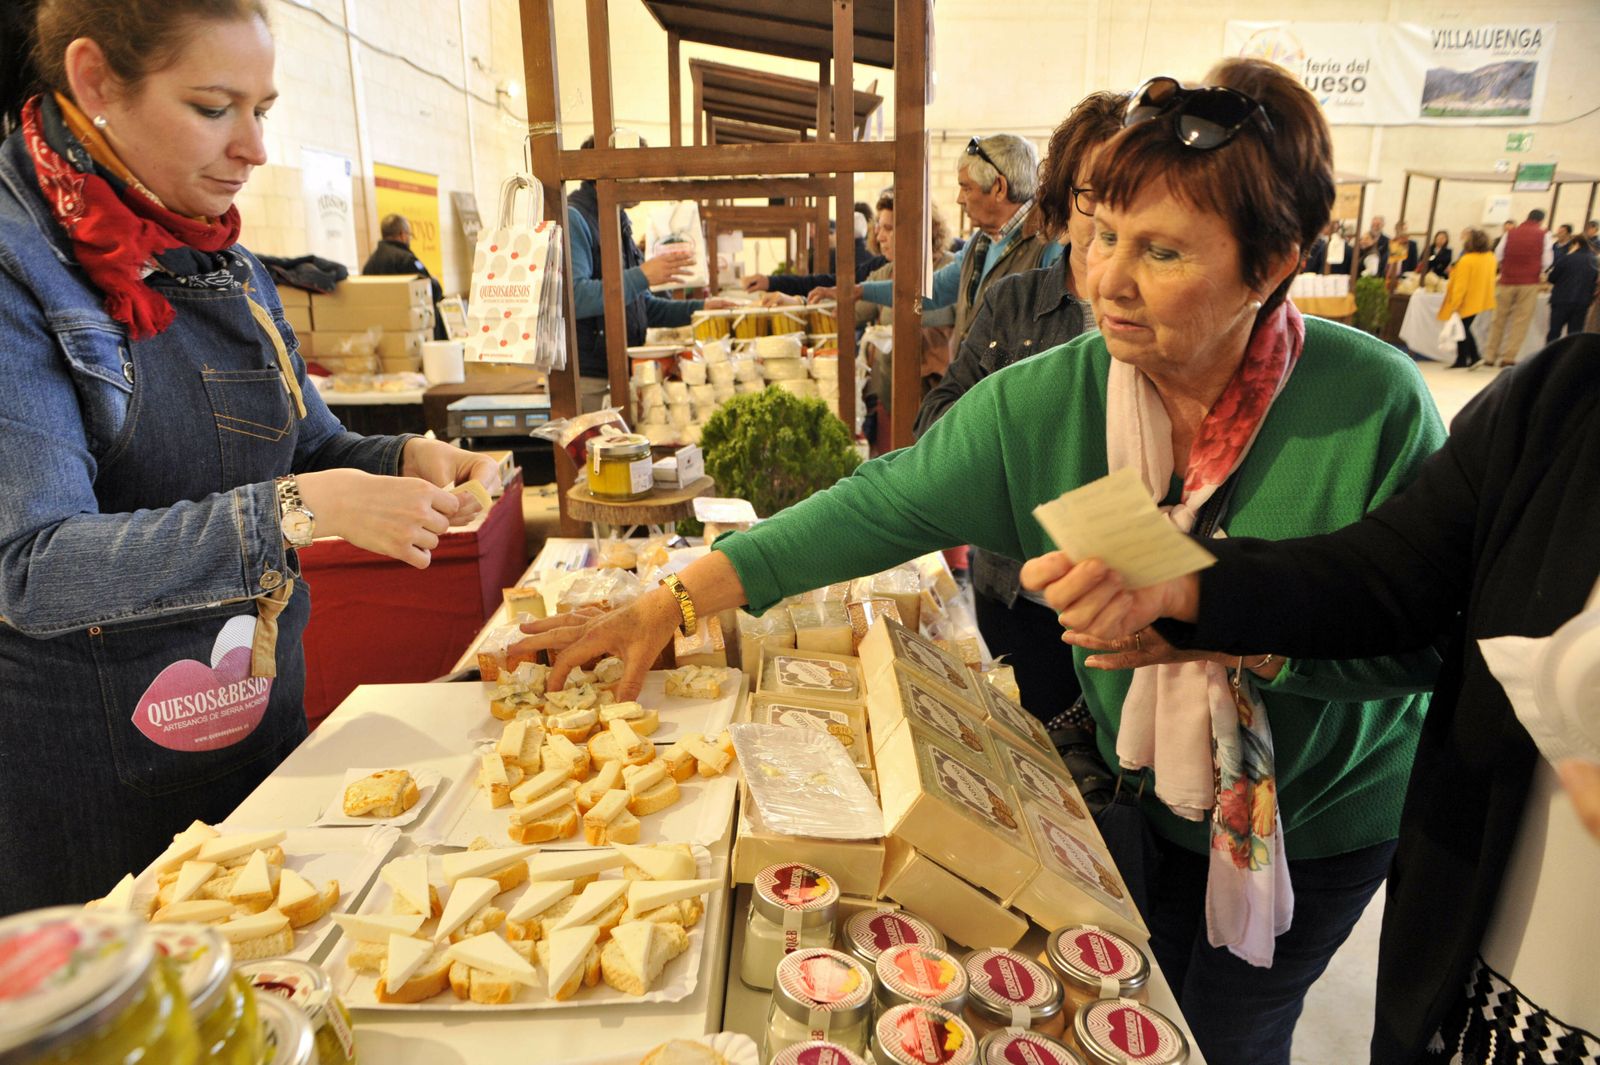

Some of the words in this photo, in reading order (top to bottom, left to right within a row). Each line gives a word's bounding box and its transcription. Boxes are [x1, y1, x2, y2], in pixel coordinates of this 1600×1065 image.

[1430, 28, 1543, 49] VILLALUENGA
[1306, 56, 1342, 74] feria
[1346, 57, 1372, 75] del
[1303, 75, 1368, 94] ueso
[147, 676, 269, 727] QUESOS&BESOS
[163, 714, 209, 733] ARTESANOS
[209, 711, 220, 721] DE
[220, 705, 245, 718] SIERRA
[785, 930, 798, 949] Q&B
